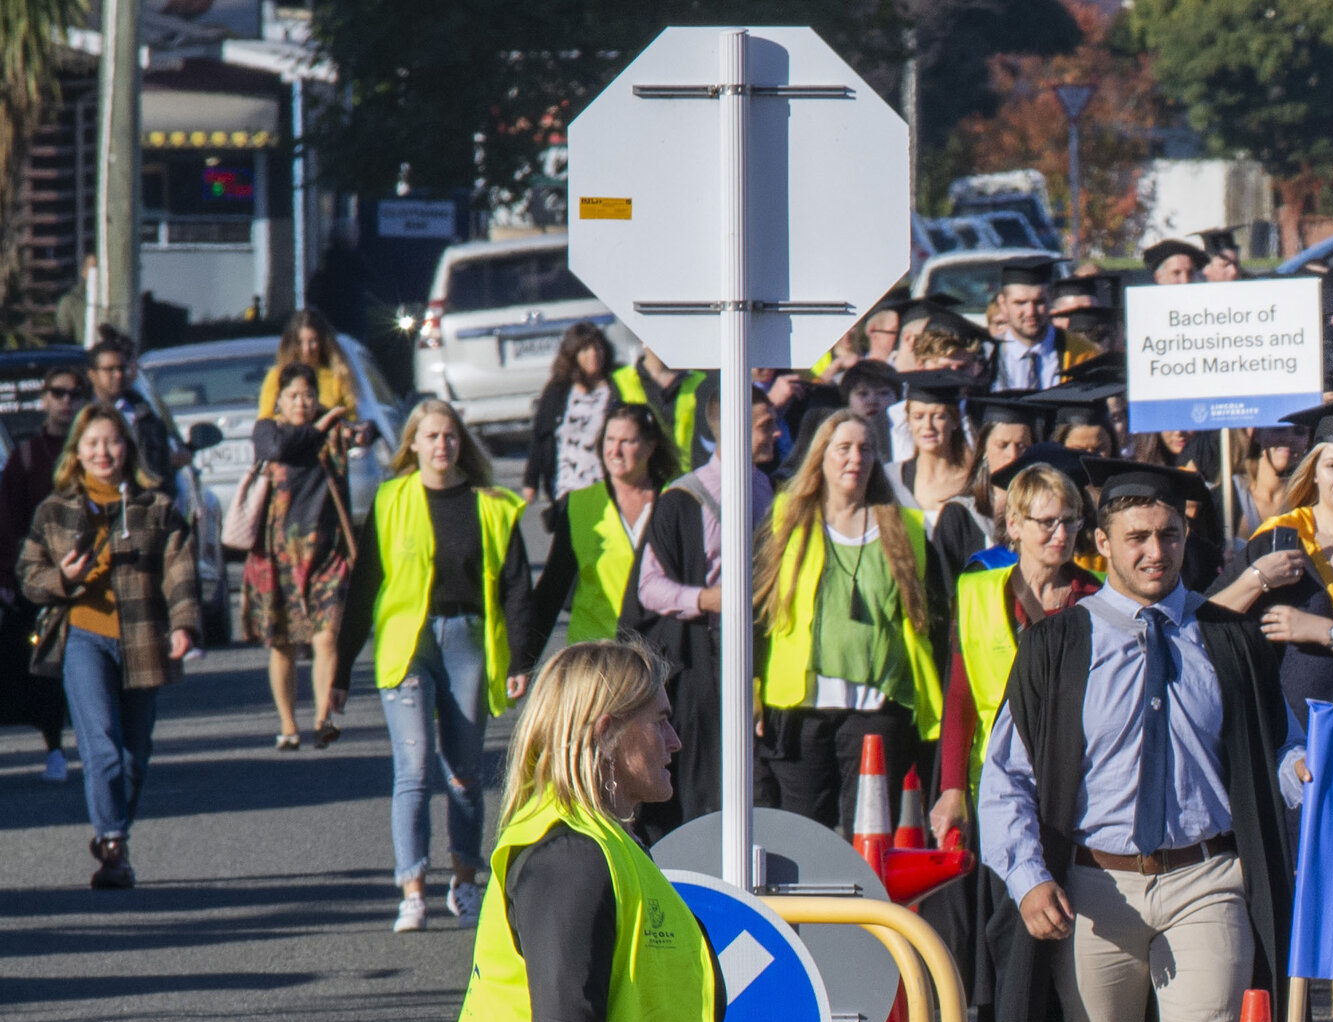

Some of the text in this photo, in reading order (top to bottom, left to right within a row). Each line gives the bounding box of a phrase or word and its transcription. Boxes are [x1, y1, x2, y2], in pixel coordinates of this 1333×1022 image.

[1169, 304, 1277, 327] Bachelor of
[1142, 328, 1304, 356] Agribusiness and
[1150, 355, 1297, 376] Food Marketing
